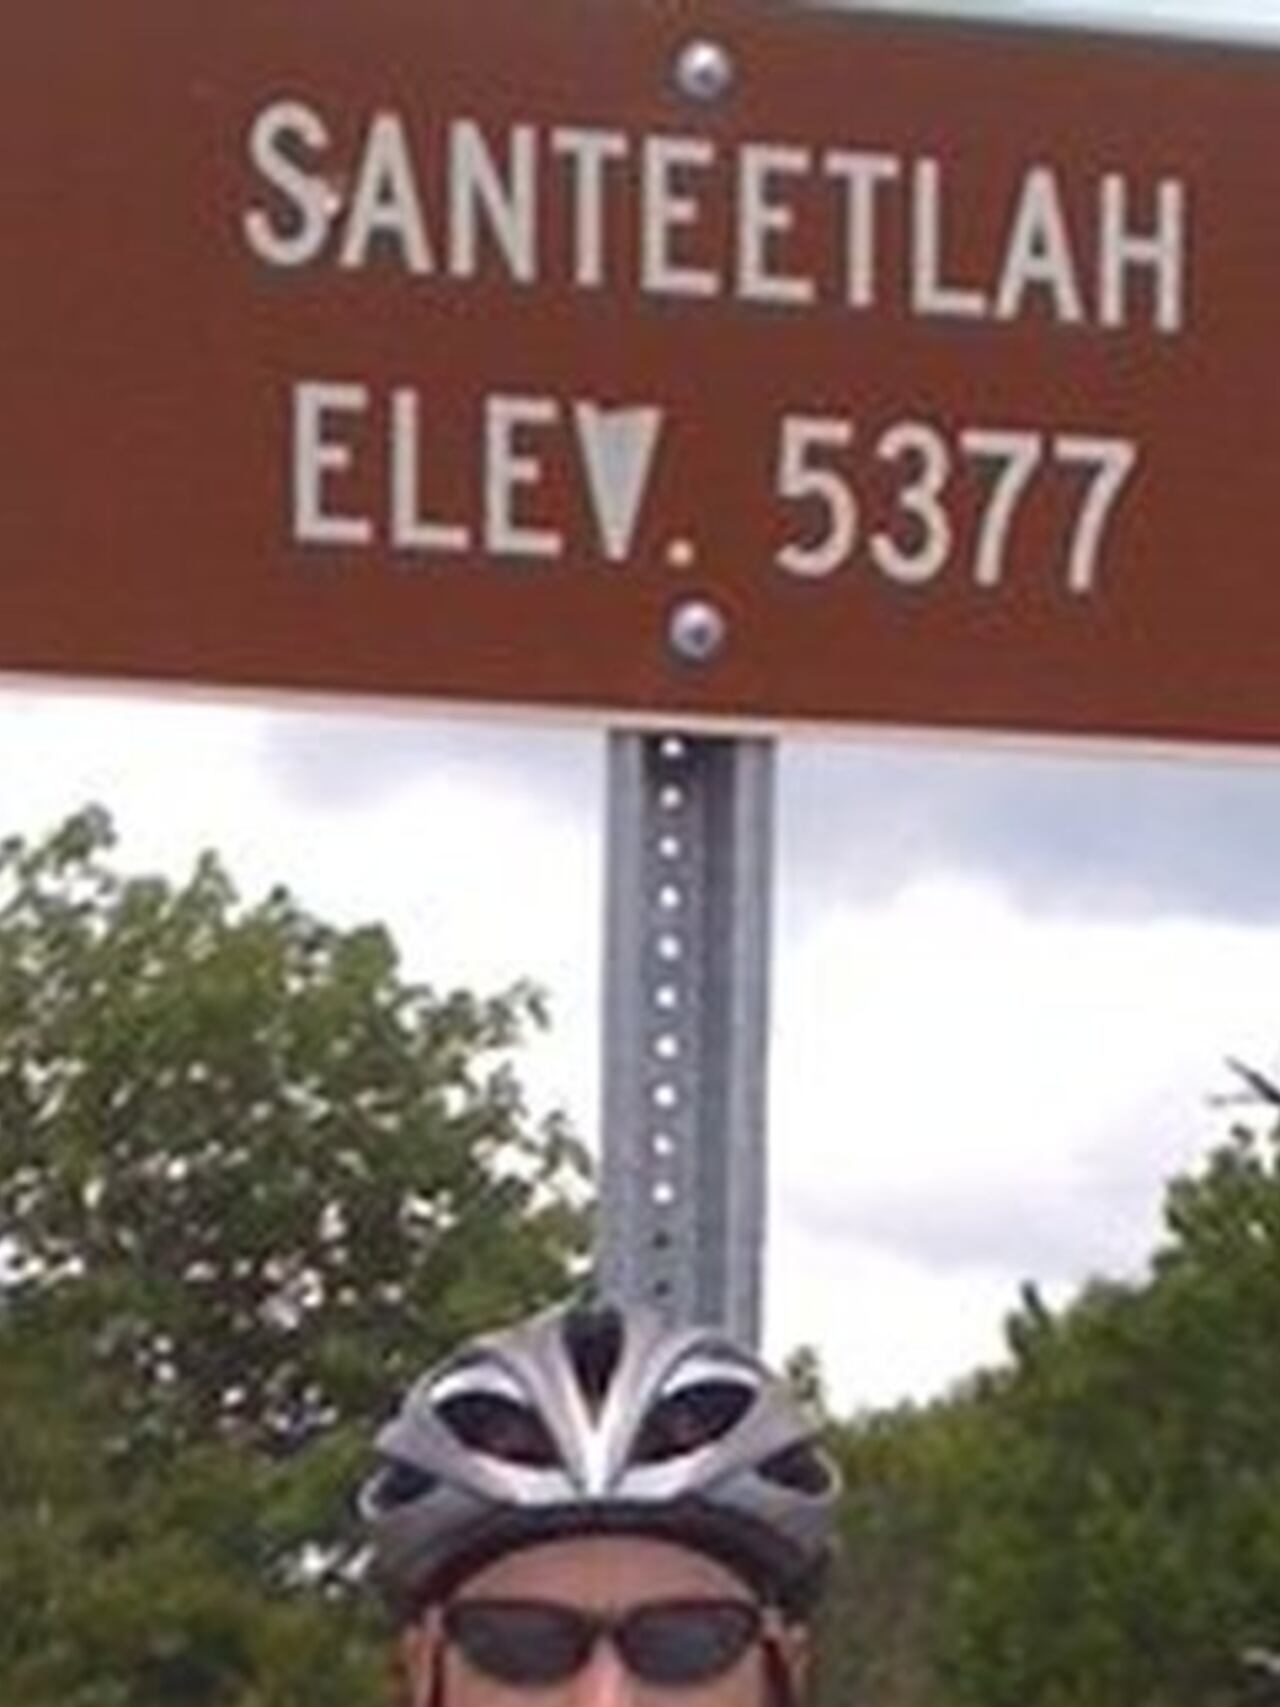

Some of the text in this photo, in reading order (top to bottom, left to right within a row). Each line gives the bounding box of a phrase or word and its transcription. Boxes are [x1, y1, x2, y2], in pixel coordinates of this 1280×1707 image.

[243, 99, 1184, 333] SANTEETLAH
[292, 377, 1137, 594] ELEV. 5377
